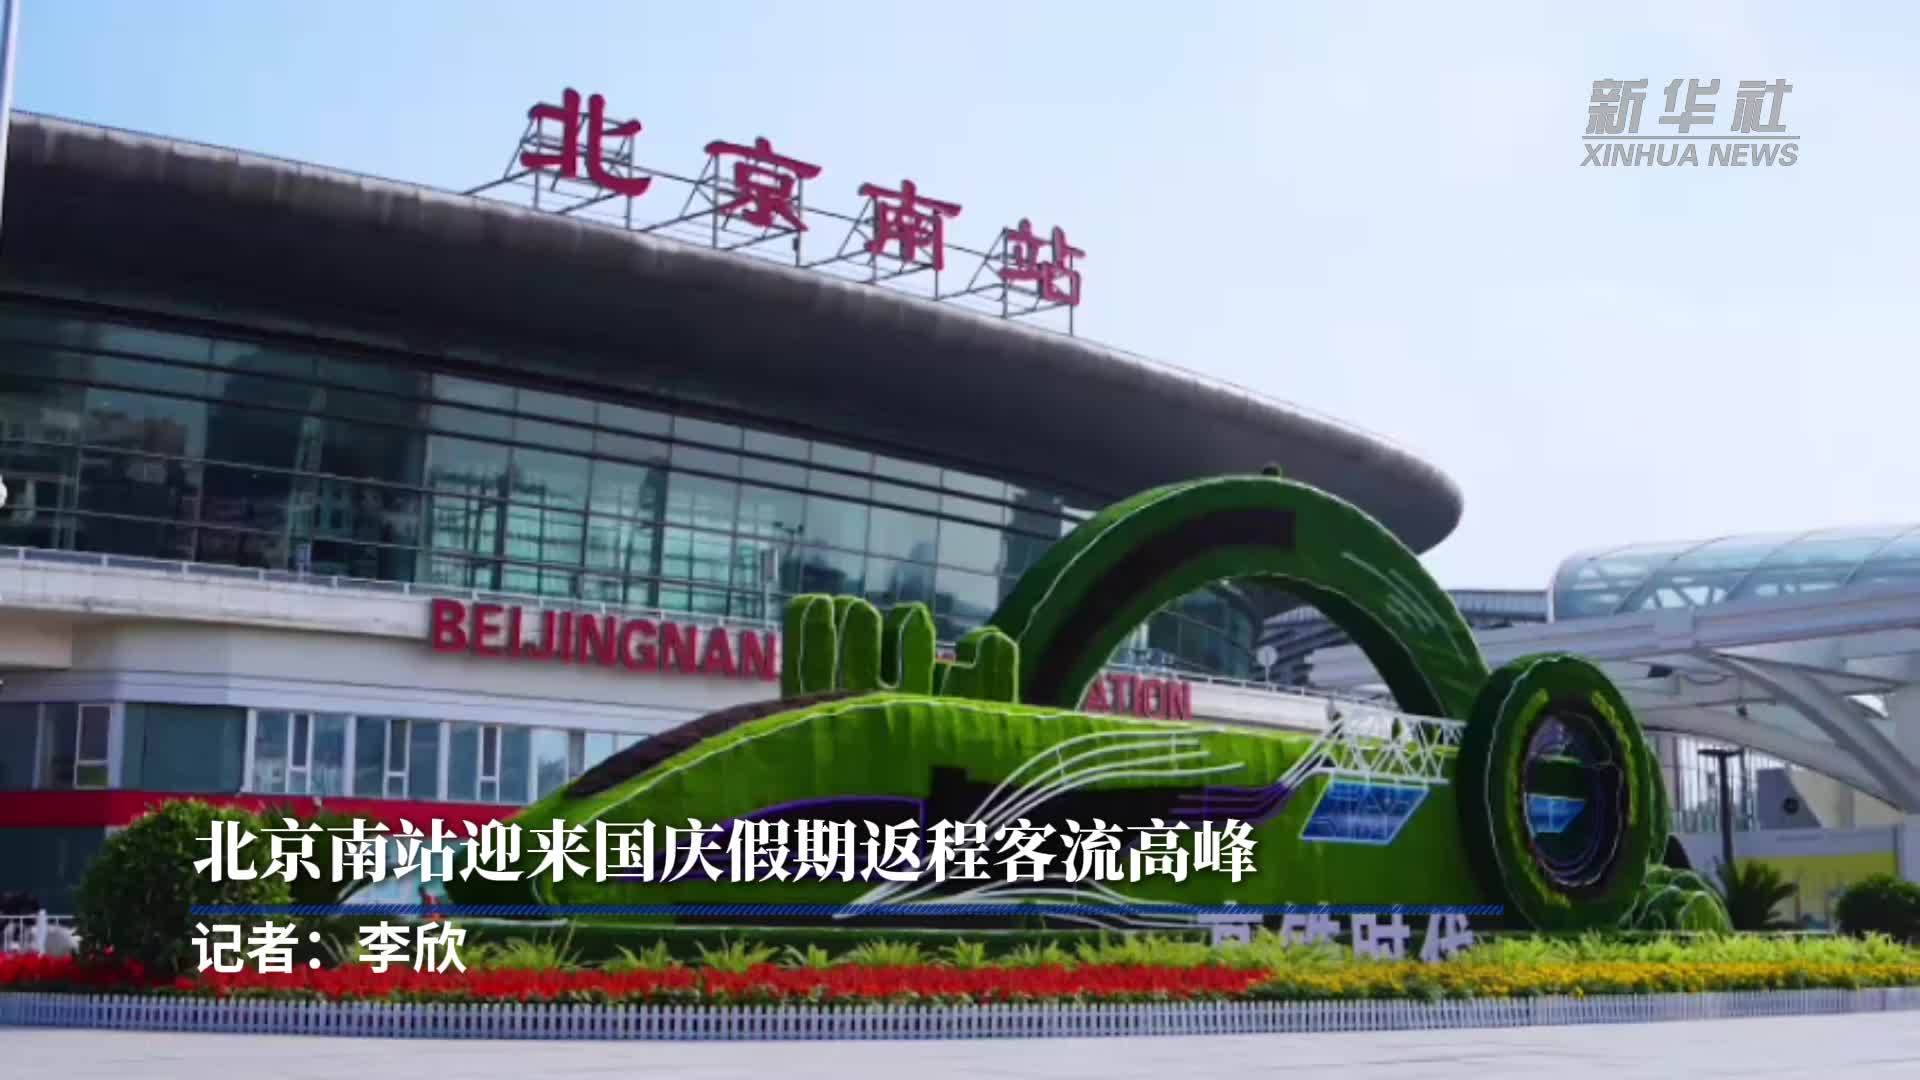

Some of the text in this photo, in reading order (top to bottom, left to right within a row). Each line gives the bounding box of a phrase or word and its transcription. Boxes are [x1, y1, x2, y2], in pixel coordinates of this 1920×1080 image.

[520, 87, 1085, 306] 北京南站
[431, 598, 1193, 720] BEIJINGNAN ATION
